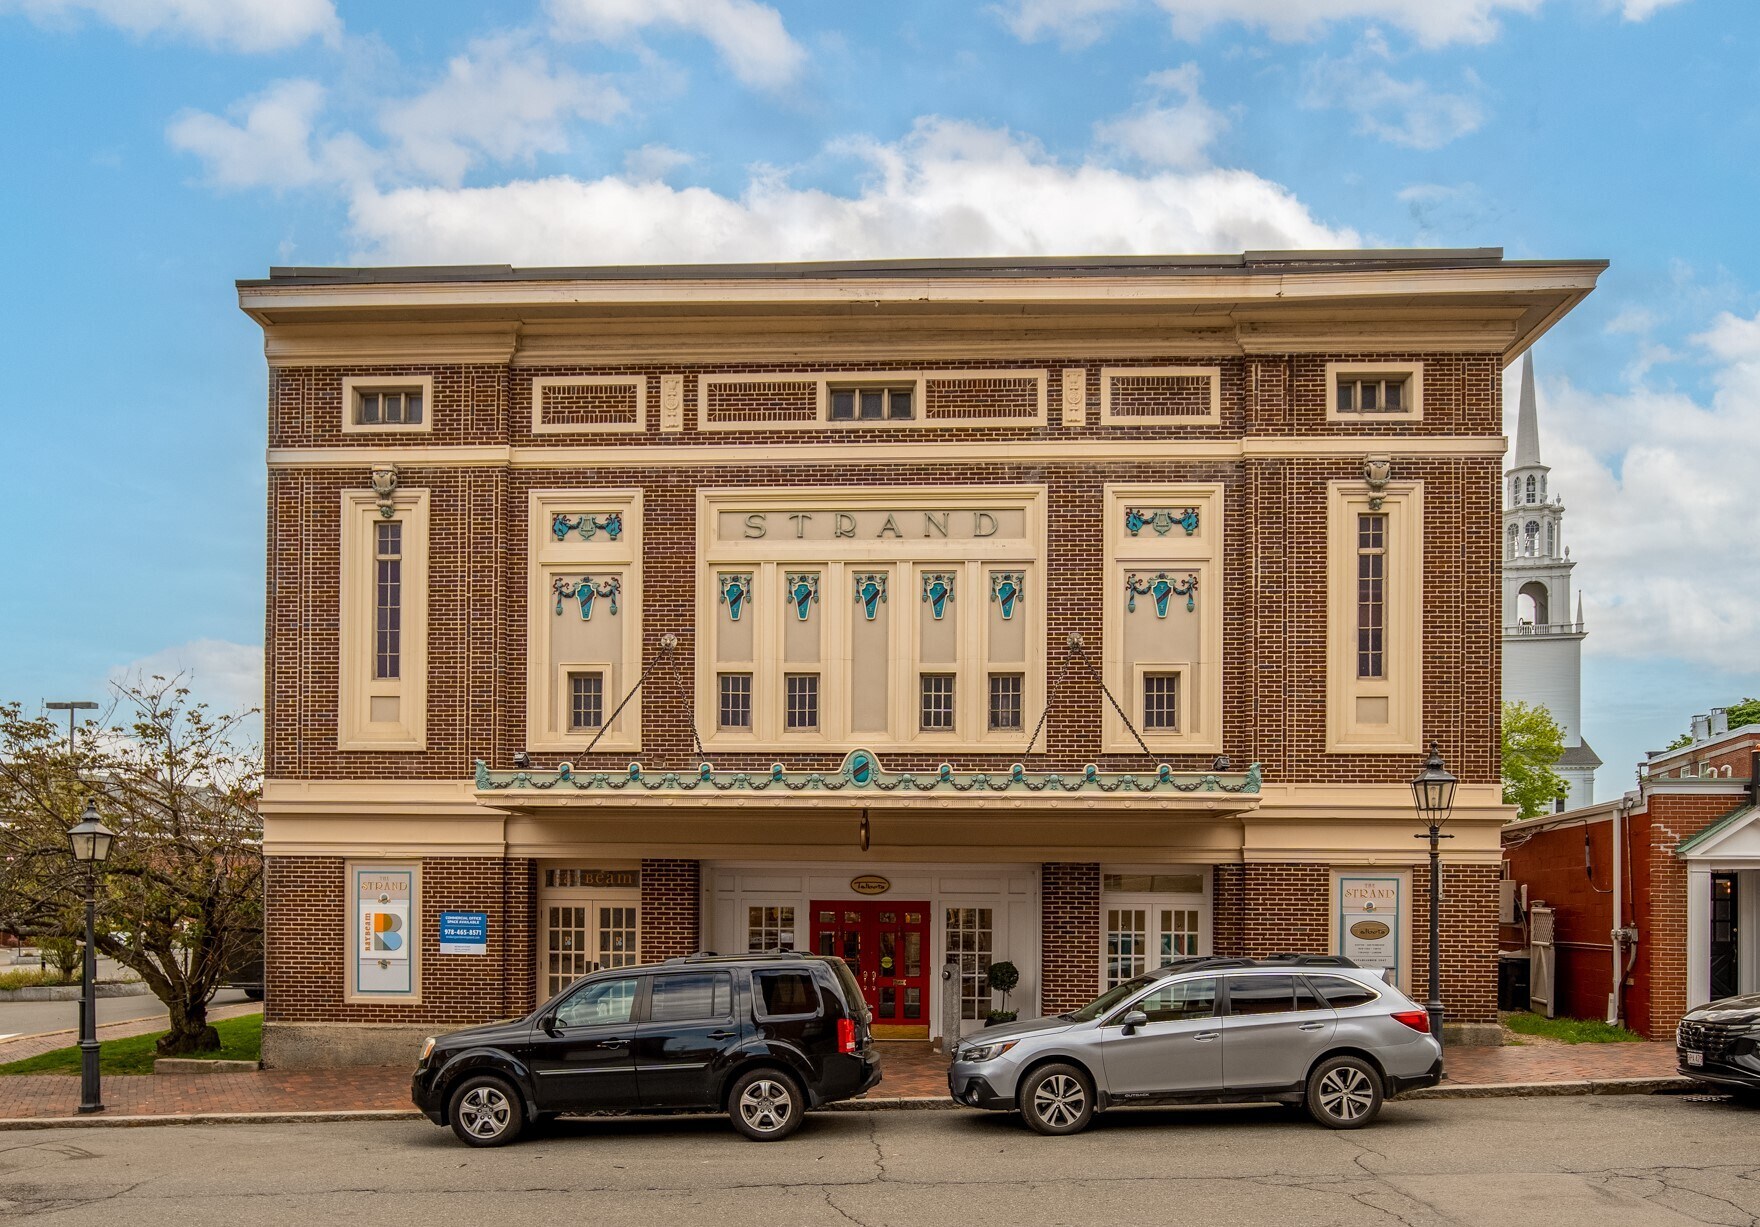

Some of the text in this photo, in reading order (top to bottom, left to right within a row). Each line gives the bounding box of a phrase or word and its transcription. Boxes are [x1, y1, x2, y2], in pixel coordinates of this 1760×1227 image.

[744, 512, 998, 539] STRAND
[361, 881, 408, 891] STRAND
[1344, 888, 1395, 899] STRAND
[444, 928, 482, 936] 978-465-8571
